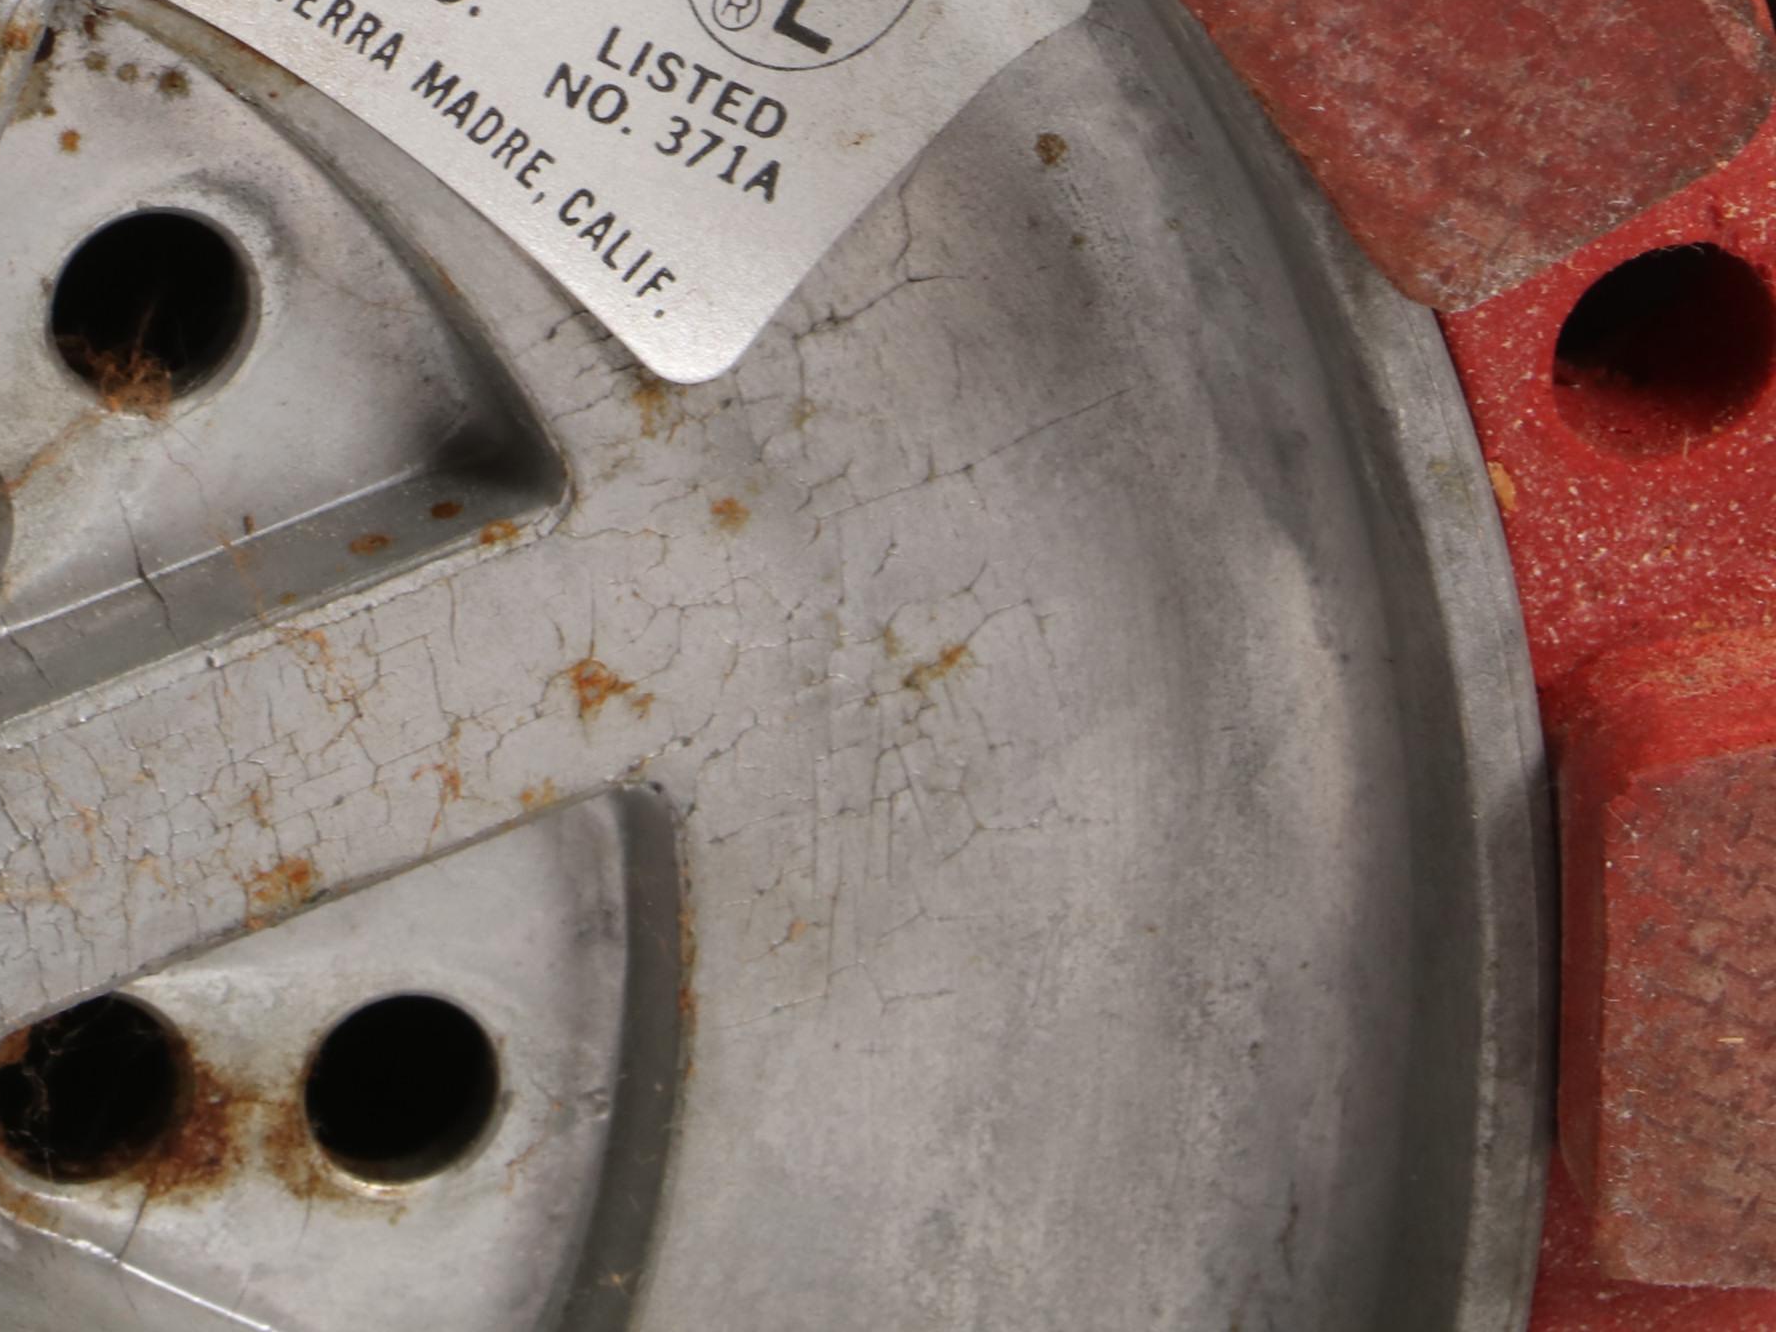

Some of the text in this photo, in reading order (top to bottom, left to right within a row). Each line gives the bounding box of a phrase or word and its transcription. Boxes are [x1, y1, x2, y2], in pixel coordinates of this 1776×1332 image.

[544, 62, 782, 204] NO. 371A
[596, 25, 789, 139] LISTED
[410, 59, 556, 205] MADRE,
[558, 188, 676, 318] CALIF.
